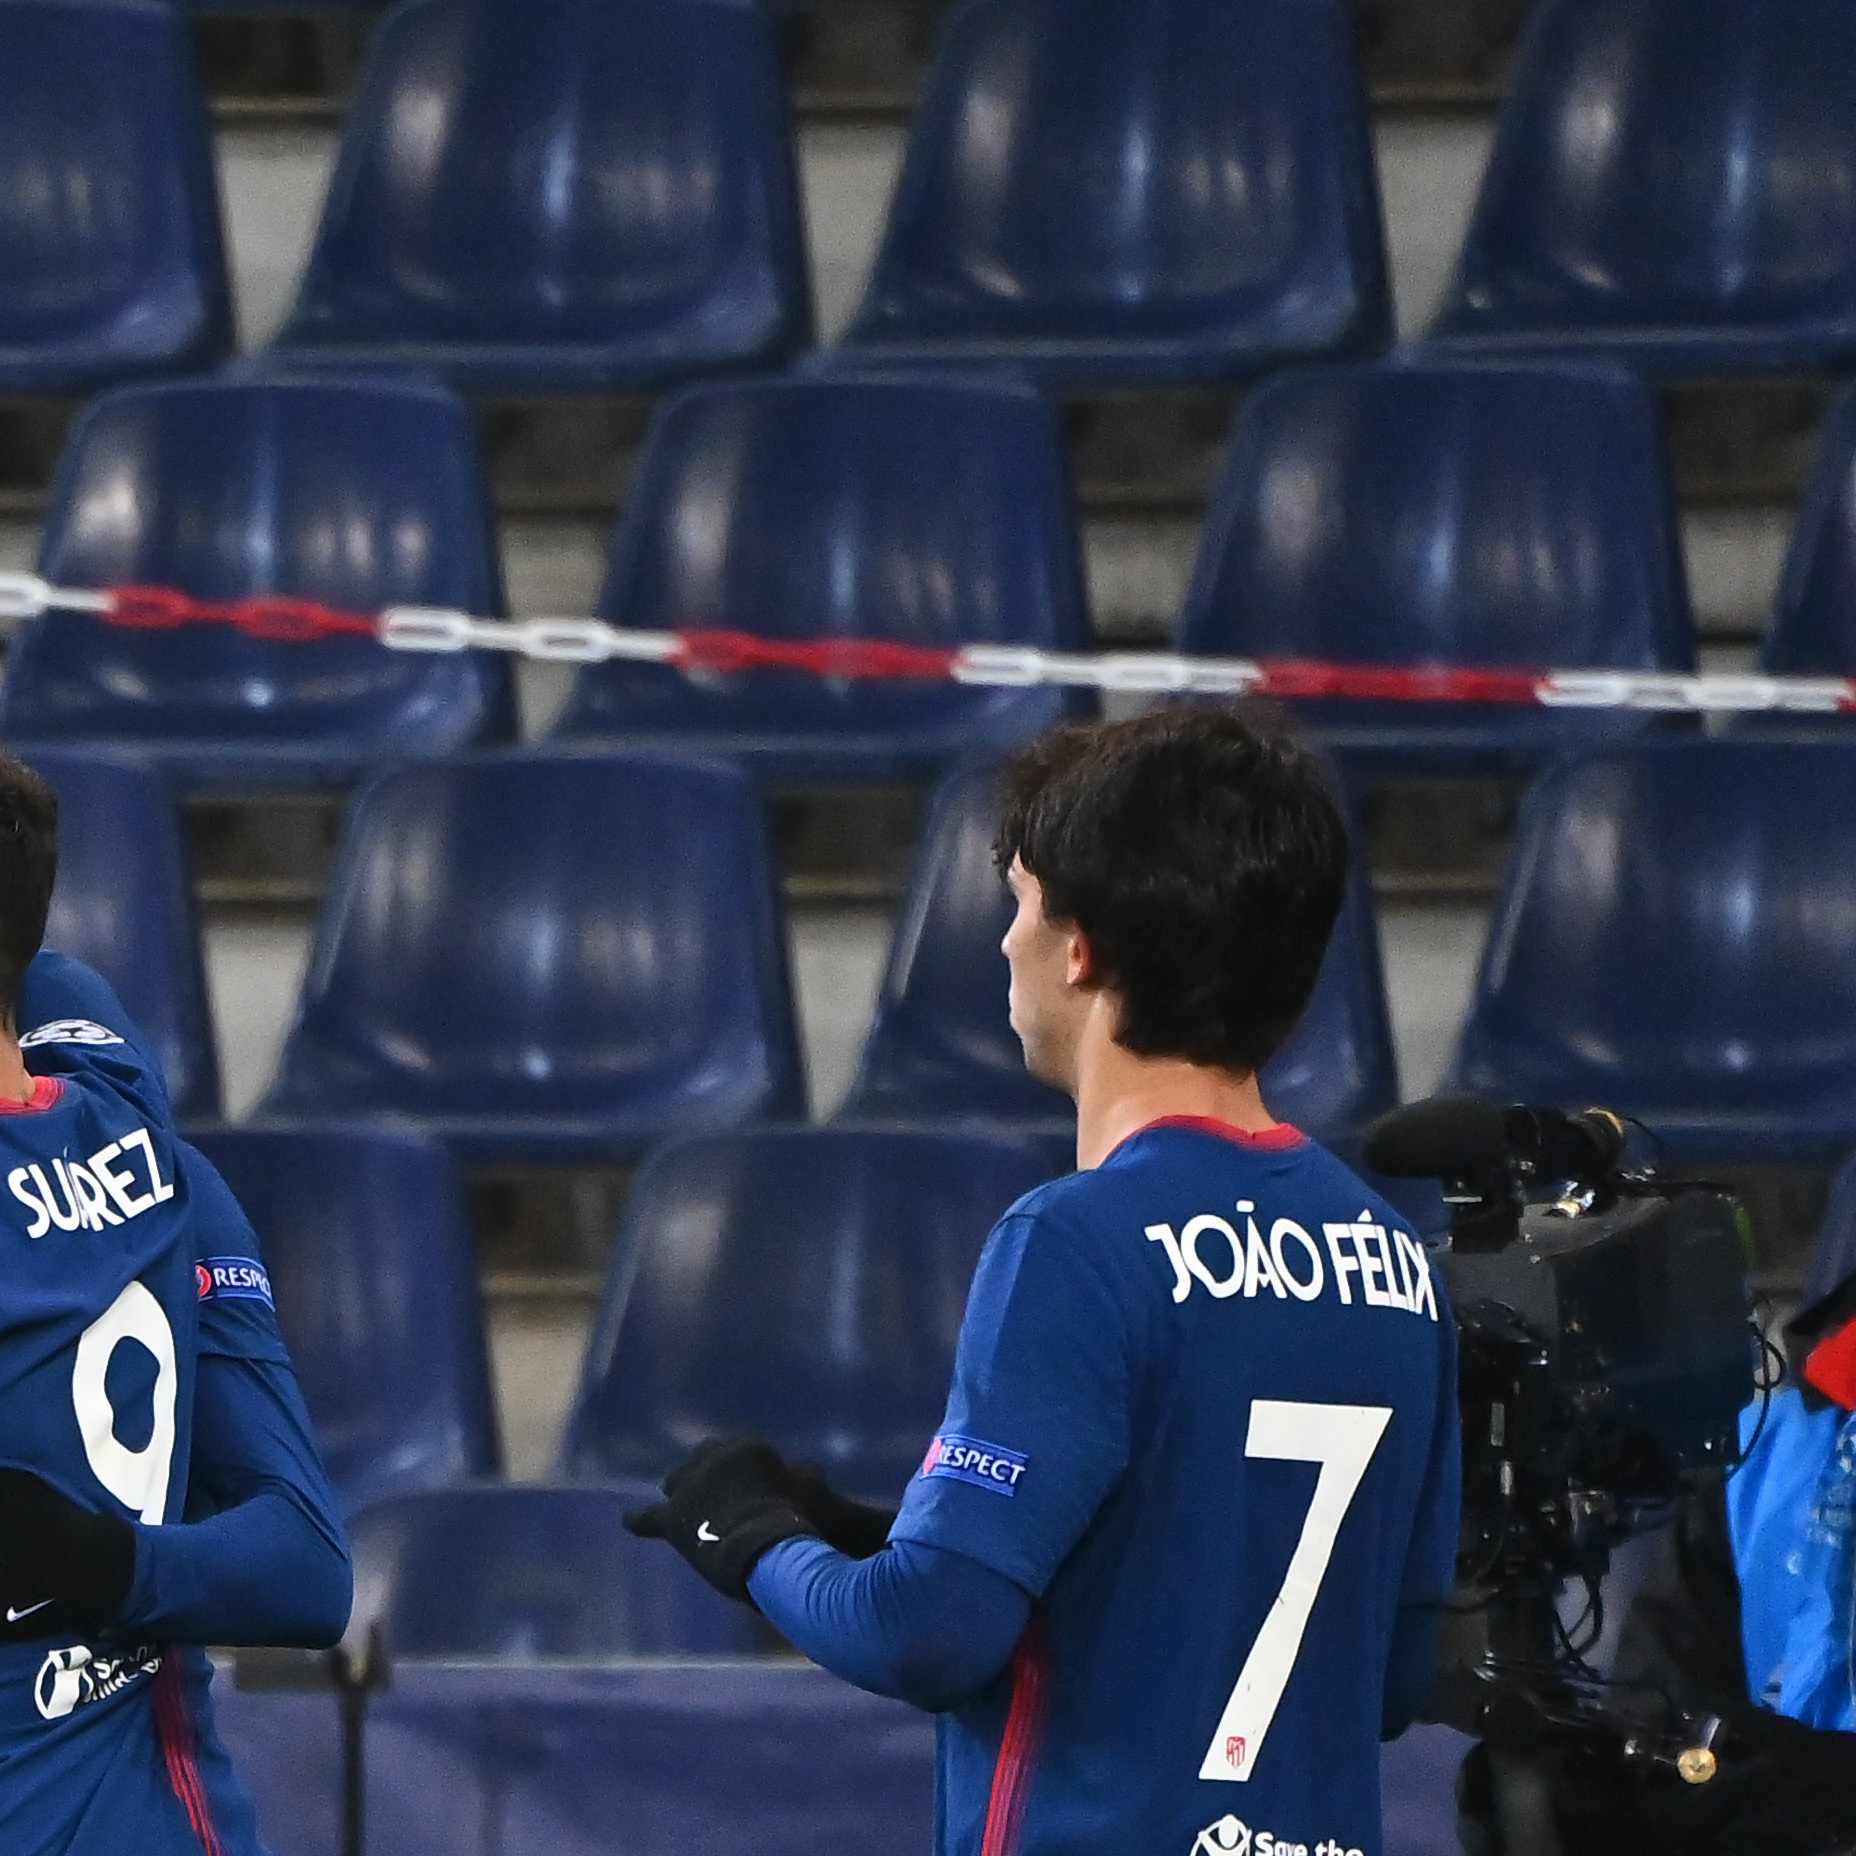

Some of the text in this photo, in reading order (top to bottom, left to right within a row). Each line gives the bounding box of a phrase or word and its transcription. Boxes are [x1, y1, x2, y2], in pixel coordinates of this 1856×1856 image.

[7, 1128, 175, 1239] SUREZ
[213, 1267, 272, 1298] RESPEC
[1144, 1199, 1439, 1322] JOÃO FÉLIX
[72, 1281, 178, 1527] 9
[1198, 1400, 1394, 1782] 7
